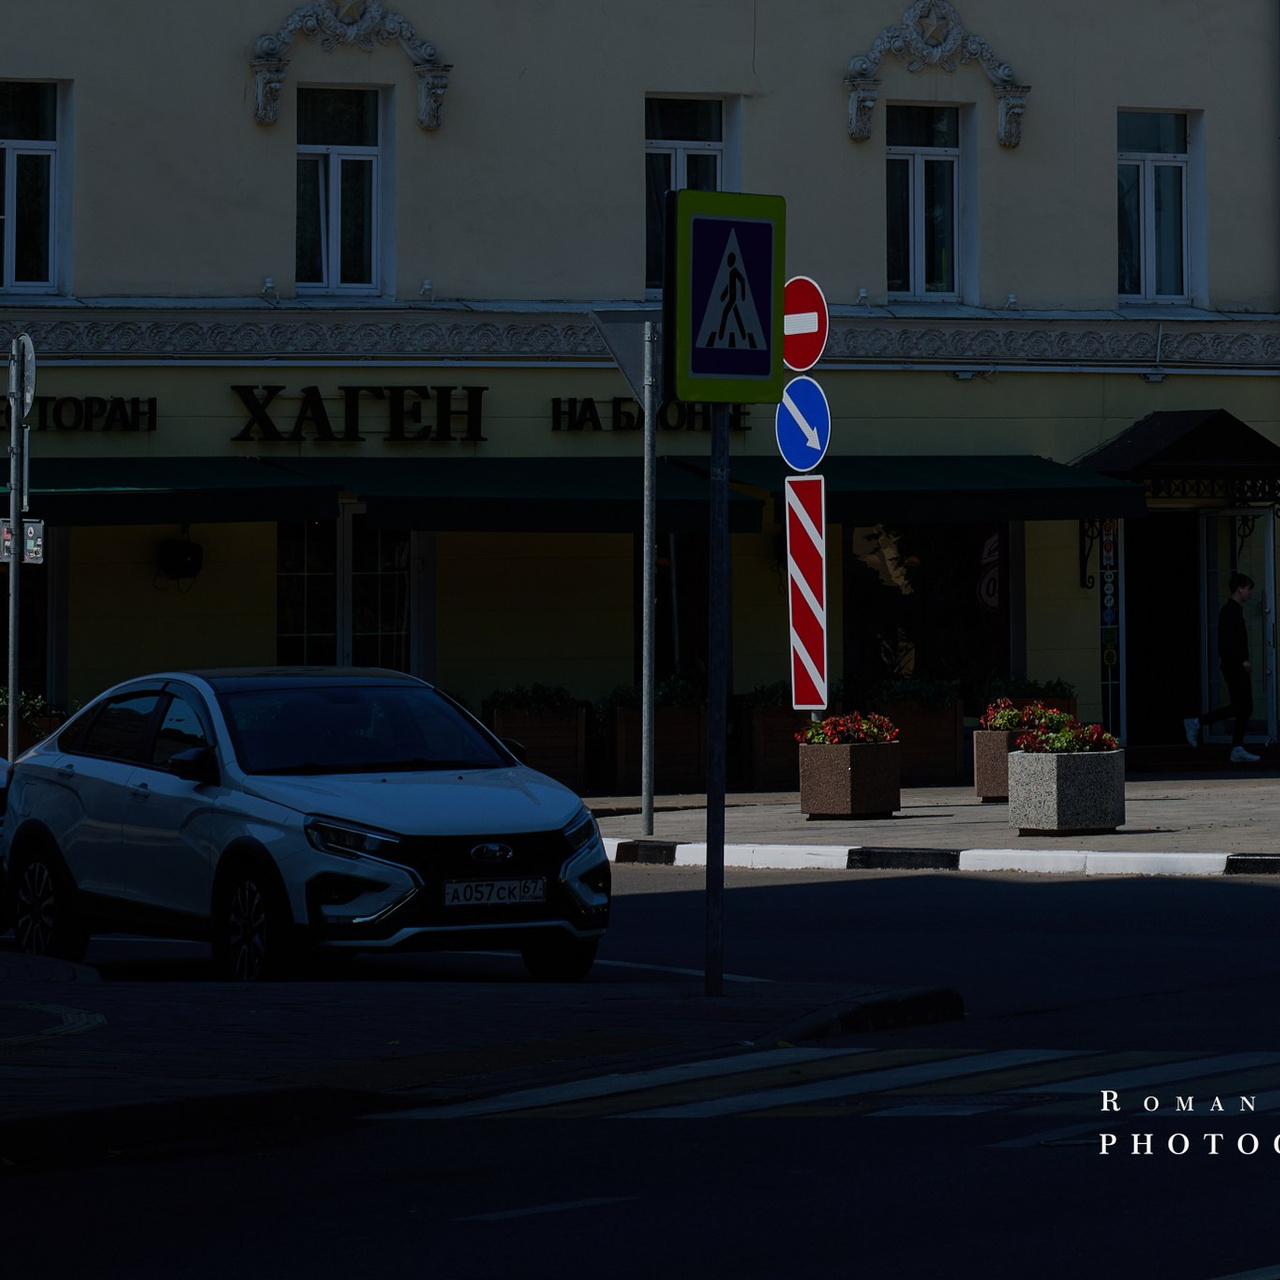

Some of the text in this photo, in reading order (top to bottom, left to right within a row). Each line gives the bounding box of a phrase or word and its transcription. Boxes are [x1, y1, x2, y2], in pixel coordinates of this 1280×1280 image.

[0, 396, 157, 431] ТОРАН
[230, 385, 489, 441] ХАГЕН
[552, 397, 602, 431] НА
[522, 880, 539, 894] 67
